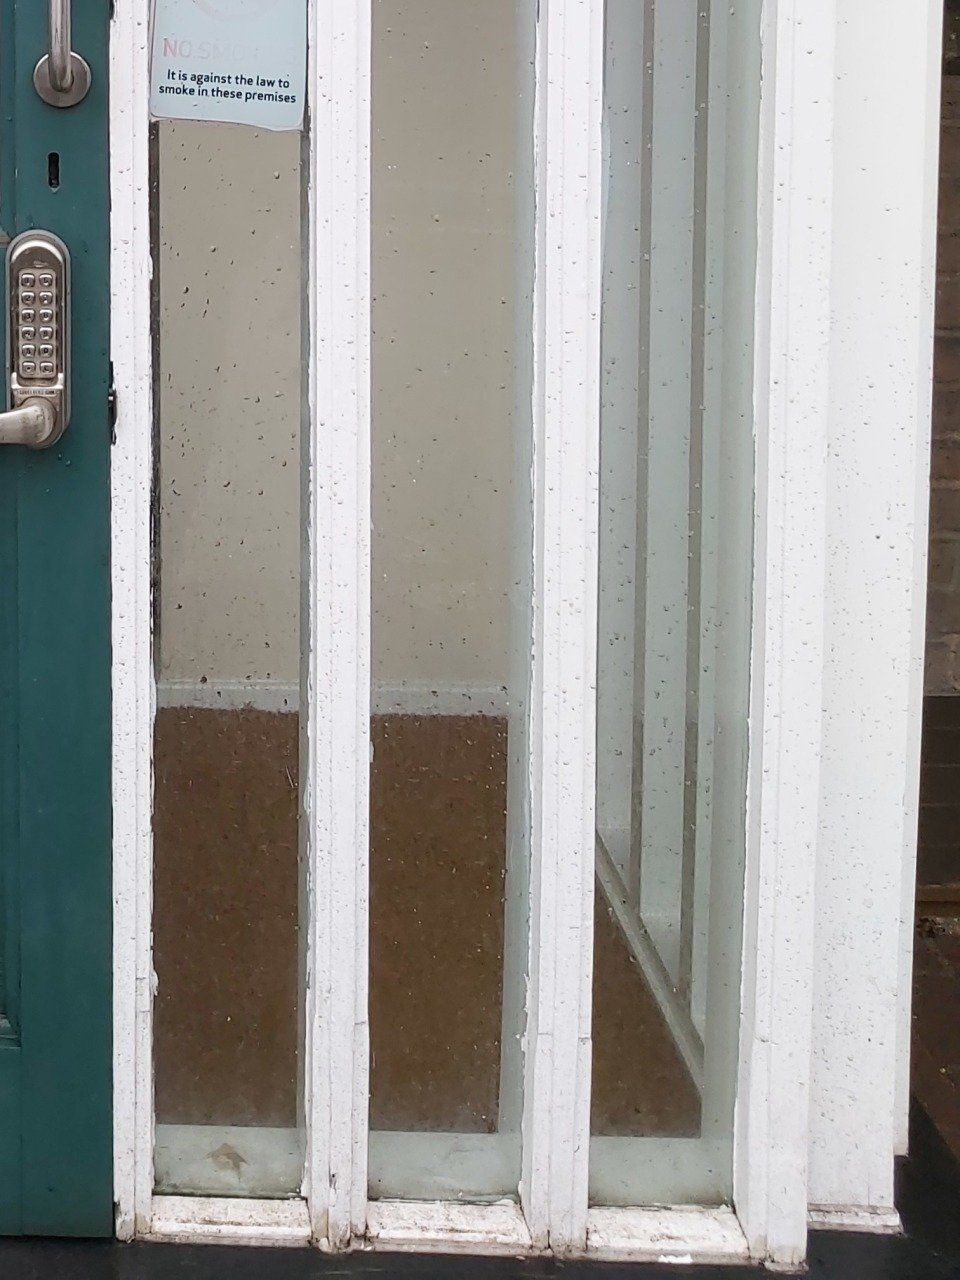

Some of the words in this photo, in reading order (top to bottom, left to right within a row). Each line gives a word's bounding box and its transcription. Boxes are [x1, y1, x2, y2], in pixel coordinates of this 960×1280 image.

[163, 38, 191, 59] NO
[167, 69, 176, 80] It
[178, 70, 188, 81] is
[190, 72, 232, 85] against
[234, 74, 254, 86] the
[256, 75, 275, 88] law
[278, 77, 290, 89] to
[158, 84, 195, 96] smoke
[197, 85, 208, 97] in
[211, 87, 243, 99] these
[245, 91, 297, 103] premises
